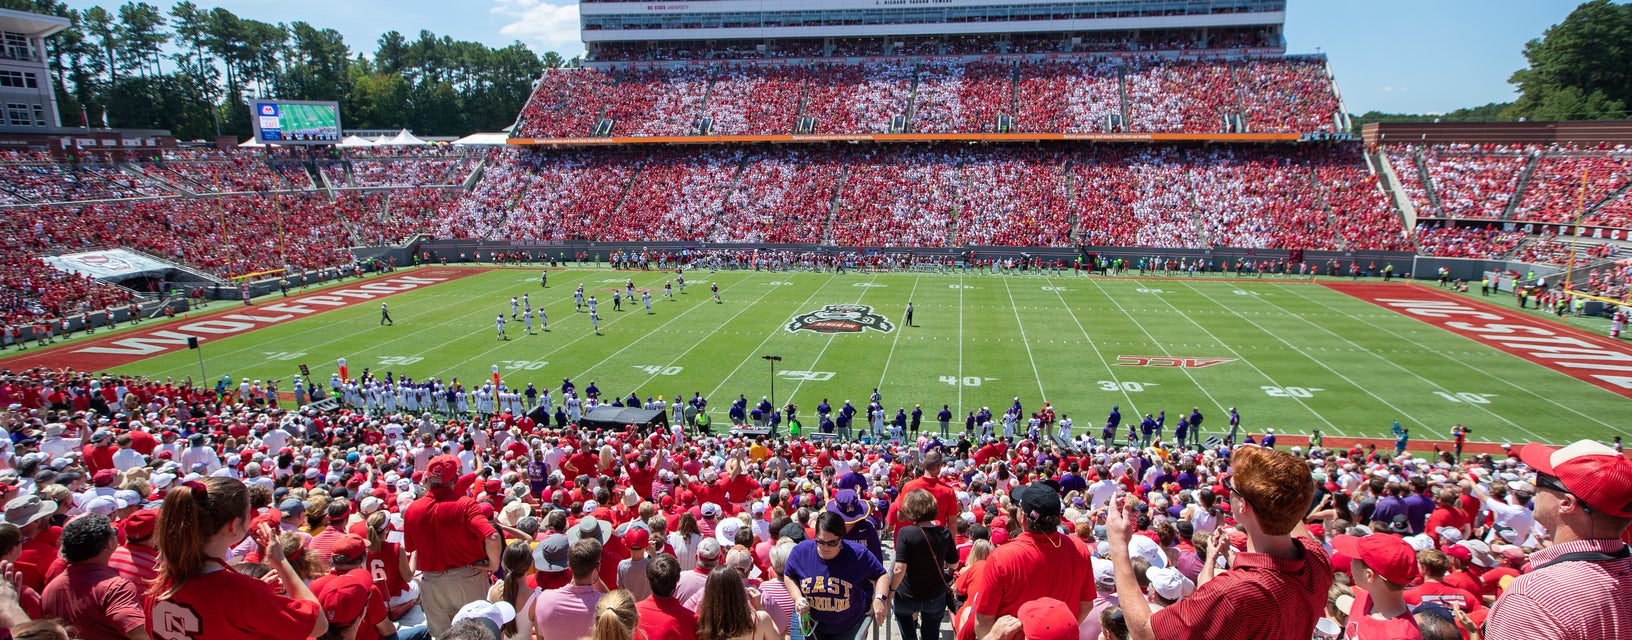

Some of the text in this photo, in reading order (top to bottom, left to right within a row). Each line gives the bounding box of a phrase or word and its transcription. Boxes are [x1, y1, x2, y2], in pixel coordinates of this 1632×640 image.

[69, 275, 448, 355] WOLFPACK
[378, 356, 425, 365] 20
[505, 360, 549, 370] 30
[642, 365, 684, 376] 40
[777, 370, 837, 381] 50
[939, 375, 982, 387] 40
[1097, 380, 1145, 392] 30
[1260, 385, 1314, 398] 20
[1432, 391, 1491, 404] 10
[801, 576, 853, 598] EAST
[806, 596, 851, 612] AROLINA
